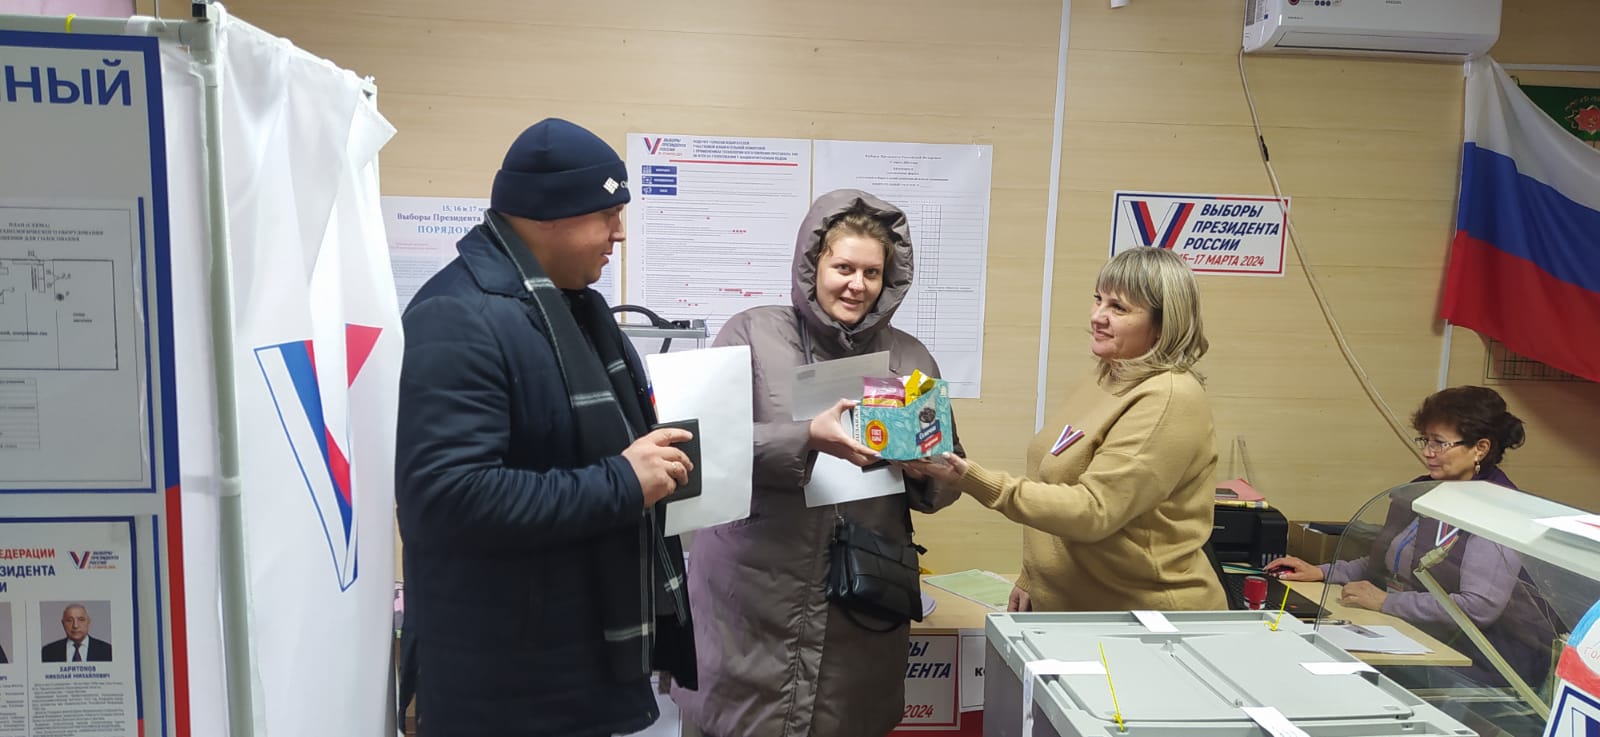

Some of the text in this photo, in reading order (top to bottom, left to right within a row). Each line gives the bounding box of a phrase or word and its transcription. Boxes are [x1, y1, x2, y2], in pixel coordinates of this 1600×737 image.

[4, 58, 131, 106] НЫЙ
[397, 213, 481, 222] Выборы Президента
[1200, 203, 1264, 218] ВЫБОРЫ
[417, 225, 470, 234] ПОРЯДОК
[1191, 220, 1280, 237] ПРЕЗИДЕНТА
[1183, 237, 1241, 252] РОССИИ
[1206, 255, 1239, 267] МАРТА
[1239, 256, 1265, 267] 2024
[906, 663, 951, 679] ЕНТА
[903, 705, 934, 718] 2024
